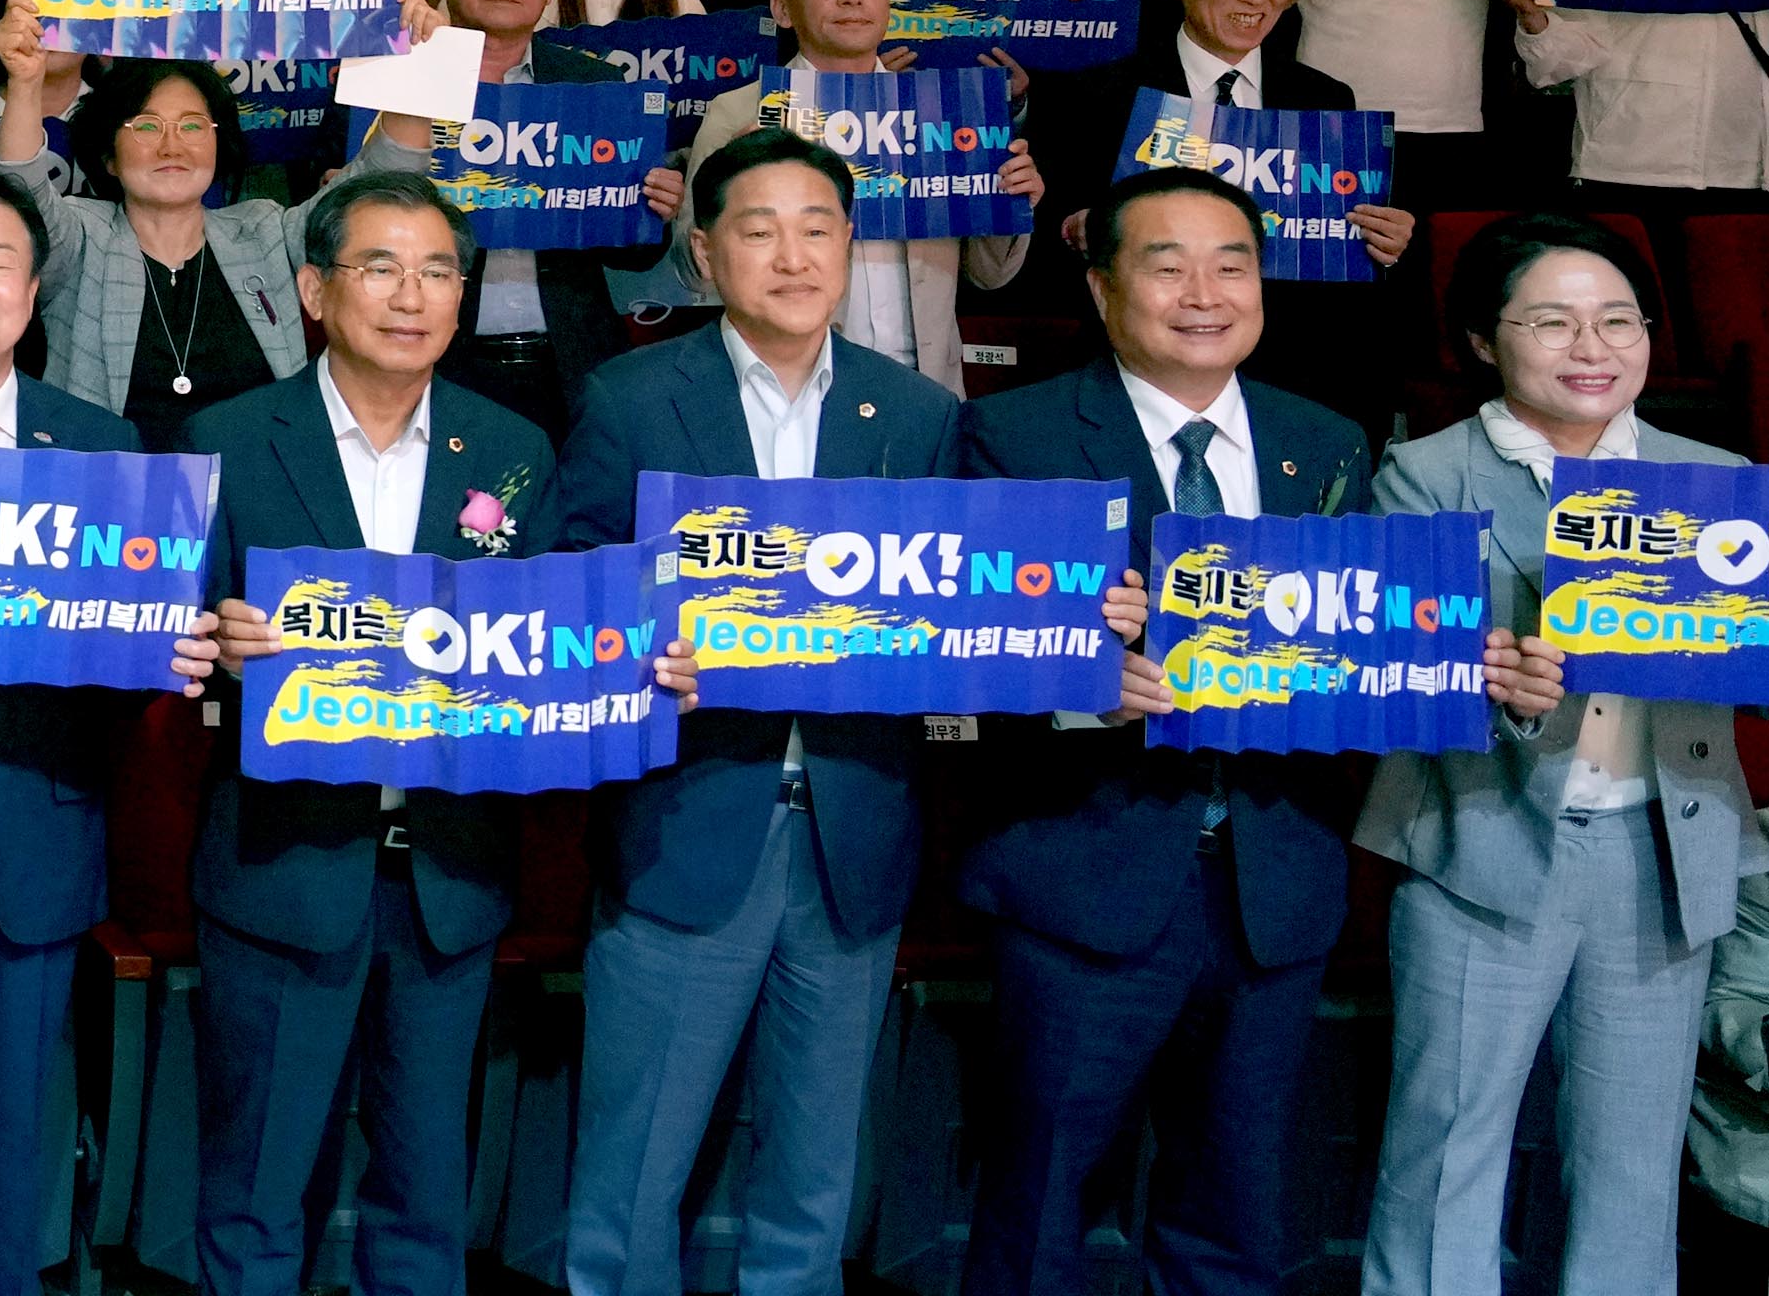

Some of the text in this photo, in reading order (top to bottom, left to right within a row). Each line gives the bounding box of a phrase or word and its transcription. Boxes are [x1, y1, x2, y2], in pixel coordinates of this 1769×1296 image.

[1011, 20, 1118, 39] 사회복지사
[456, 120, 642, 167] OK! Now
[822, 110, 916, 155] OK!
[81, 525, 203, 570] Now
[1554, 511, 1678, 556] 복지는
[680, 529, 1105, 597] 복지는 OK! Now
[48, 600, 200, 634] 사회복지사
[1262, 568, 1379, 636] OK!
[1385, 592, 1482, 629] Now
[281, 602, 654, 676] 복지는 OK! Now
[694, 617, 1102, 658] Jeonnam 사회복지사
[1359, 661, 1483, 697] 사회복지사
[281, 685, 653, 738] Jeonnam 사회복지사
